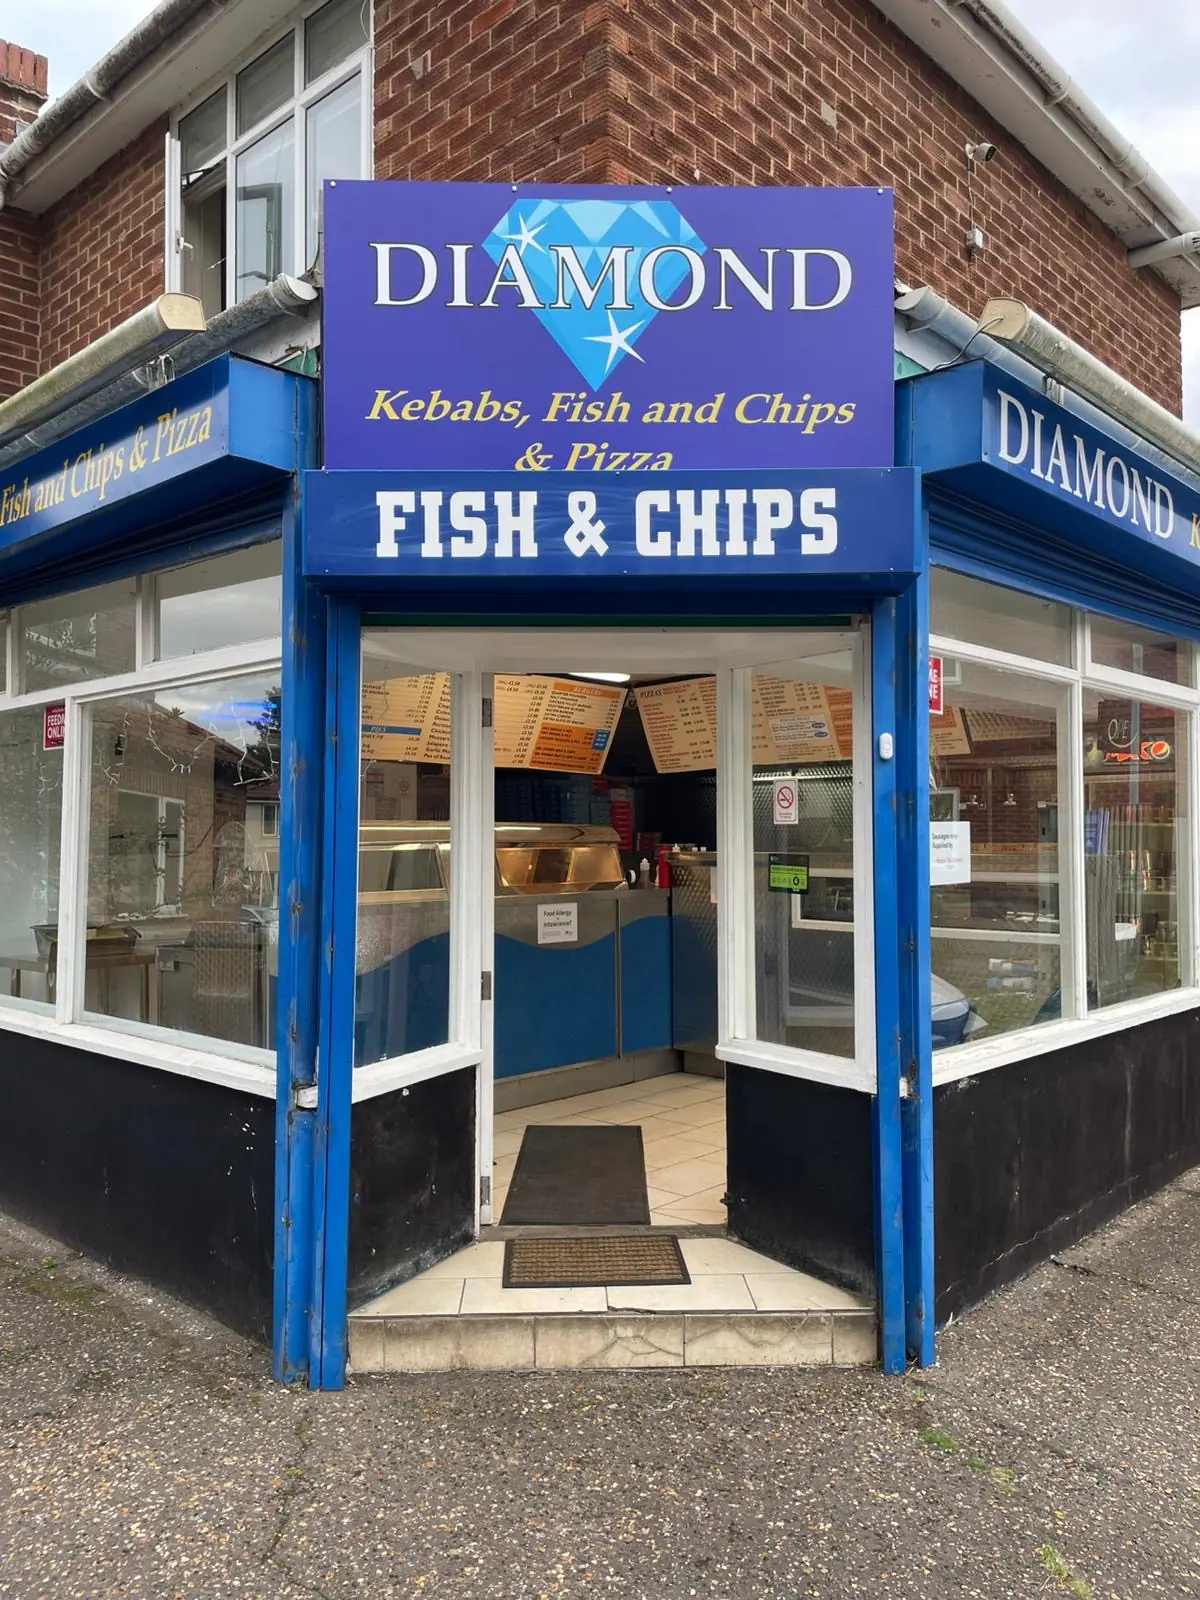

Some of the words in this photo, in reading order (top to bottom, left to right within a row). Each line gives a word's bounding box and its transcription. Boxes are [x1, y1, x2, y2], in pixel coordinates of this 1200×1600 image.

[369, 241, 852, 312] DIAMOND
[365, 390, 530, 428] Kebabs,
[542, 392, 630, 424] Fish
[643, 393, 724, 425] and
[735, 394, 856, 434] Chips
[0, 477, 31, 527] Fish
[34, 459, 68, 513] and
[70, 443, 125, 500] Chips
[129, 425, 148, 472] &
[152, 406, 212, 463] Pizza
[514, 442, 554, 470] &
[564, 443, 673, 470] Pizza
[997, 389, 1174, 538] DIAMOND
[376, 491, 538, 558] FISH
[564, 490, 608, 558] &
[635, 488, 838, 556] CHIPS
